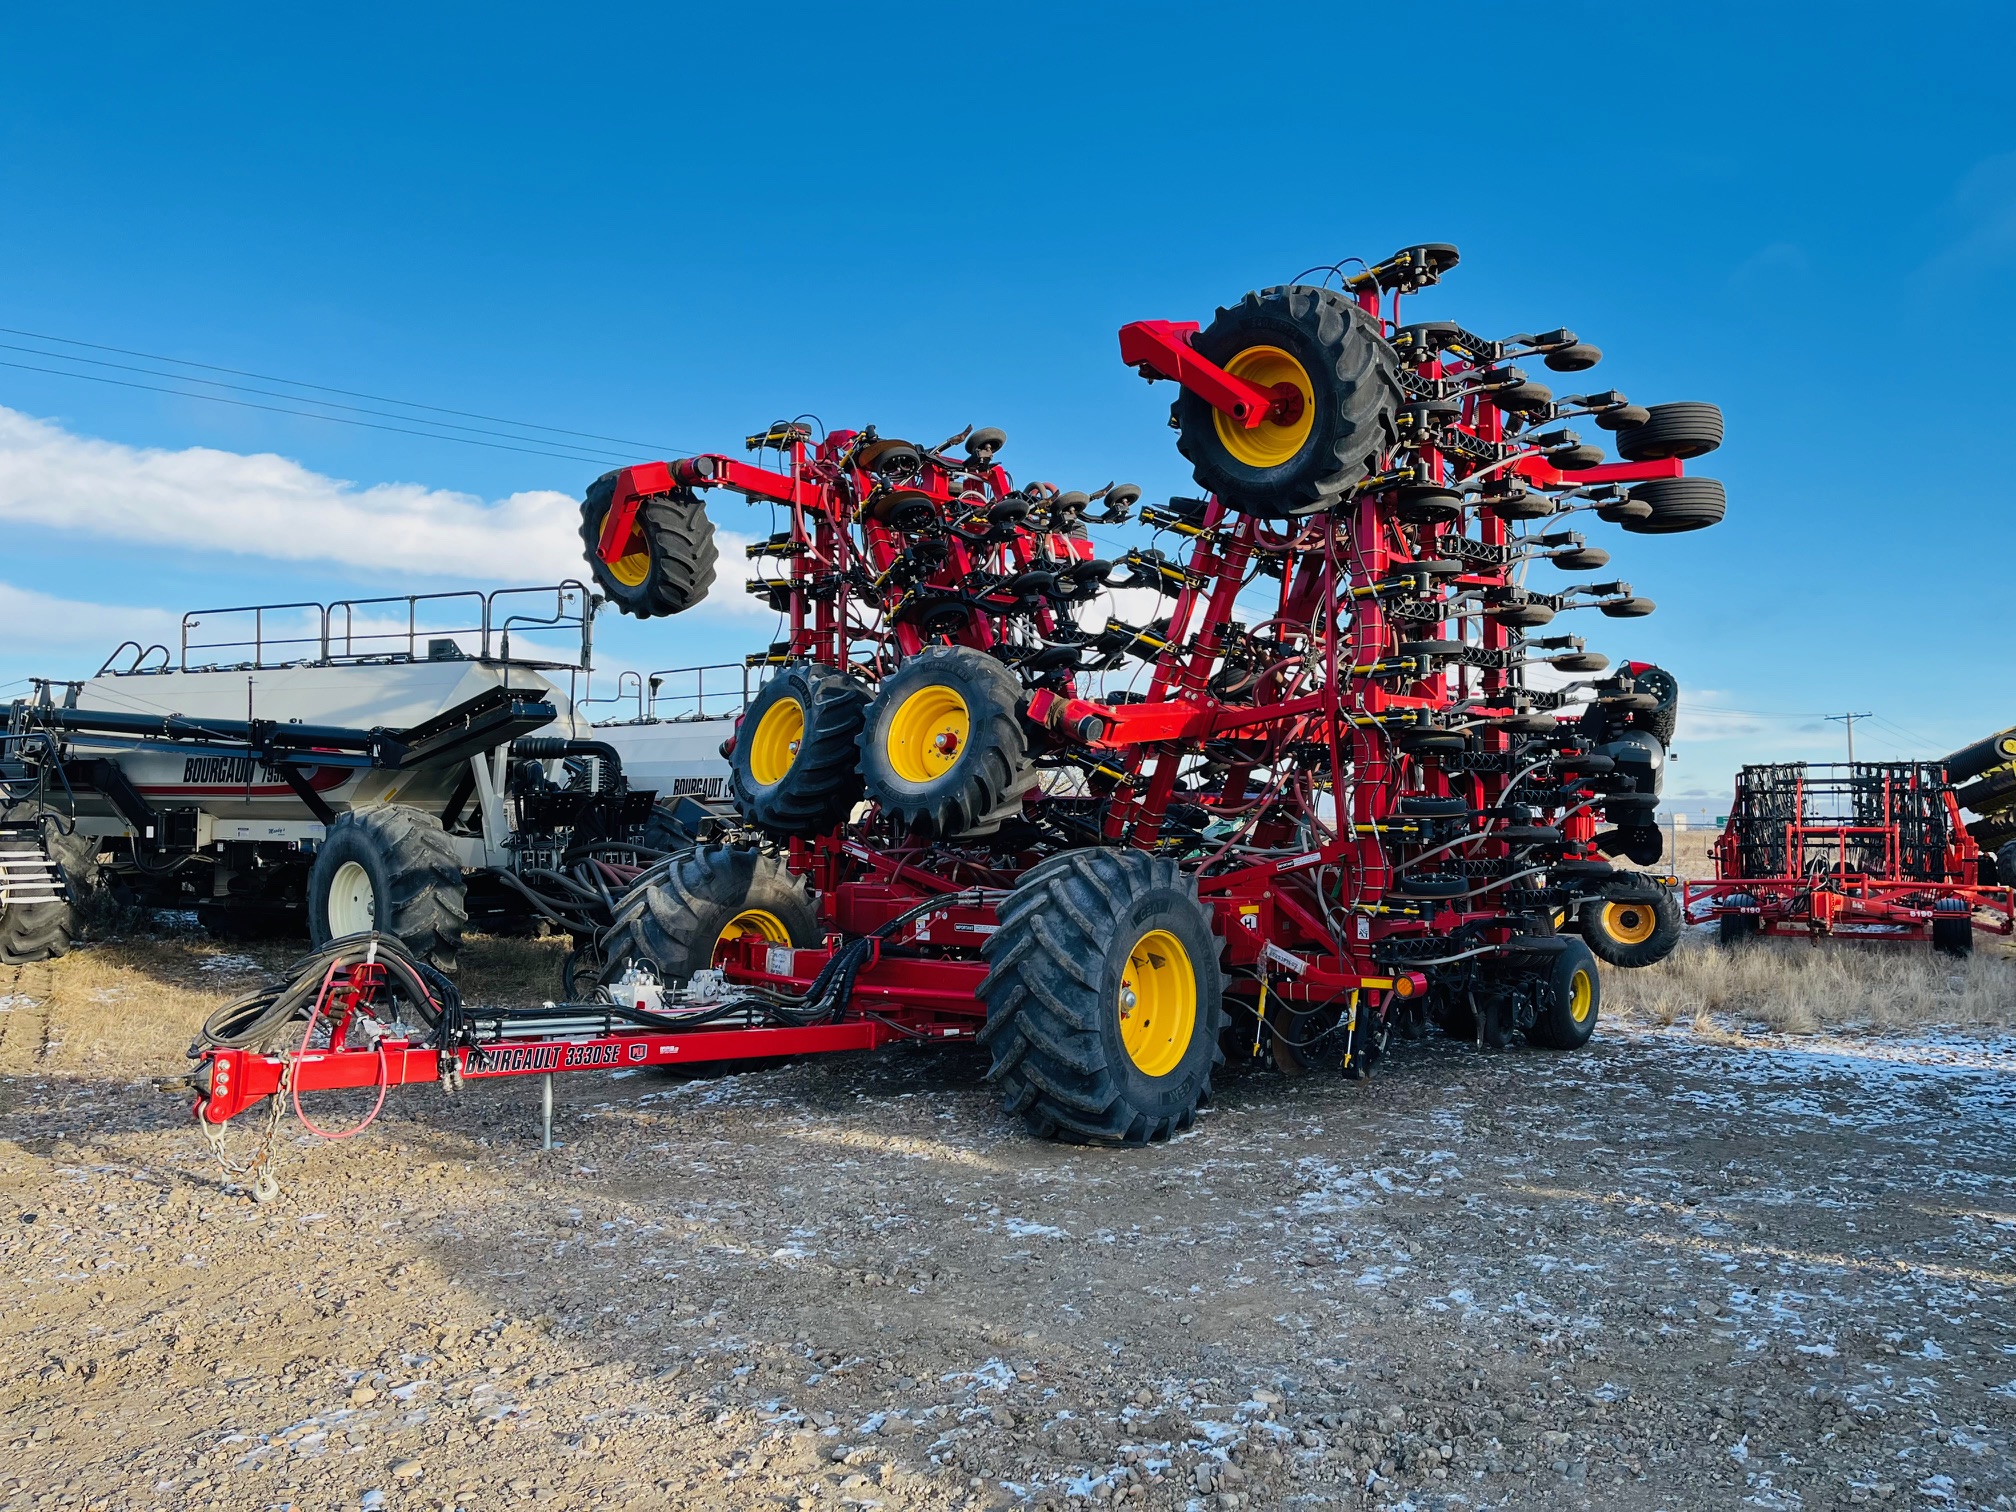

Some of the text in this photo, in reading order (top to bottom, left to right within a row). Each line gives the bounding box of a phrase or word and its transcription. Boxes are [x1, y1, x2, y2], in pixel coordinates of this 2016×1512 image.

[183, 757, 258, 783] BOURGAULT
[673, 777, 723, 798] BOURGAULT
[1910, 910, 1934, 918] 8190
[464, 1047, 563, 1075] BOURGAULT
